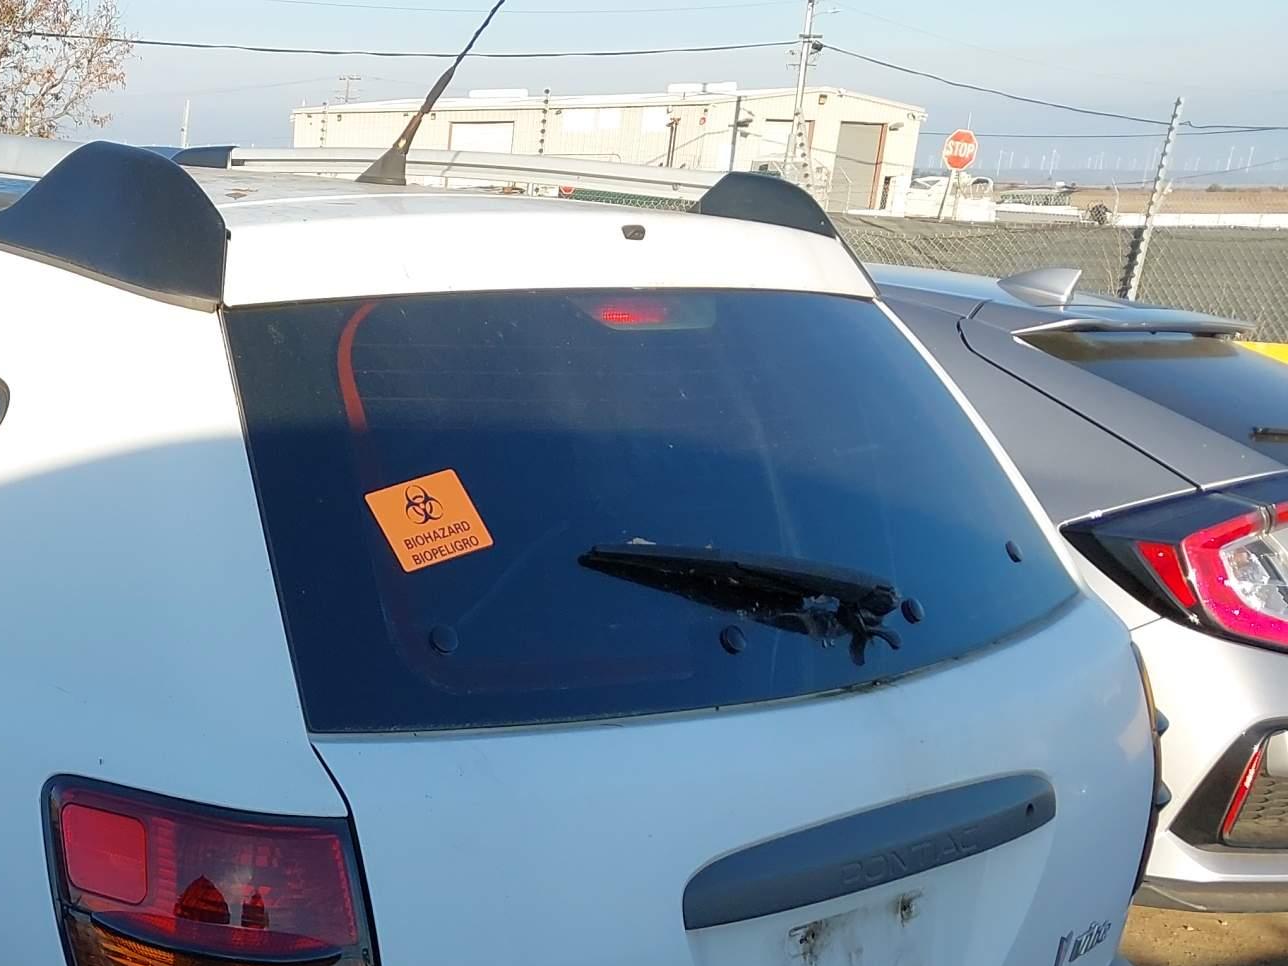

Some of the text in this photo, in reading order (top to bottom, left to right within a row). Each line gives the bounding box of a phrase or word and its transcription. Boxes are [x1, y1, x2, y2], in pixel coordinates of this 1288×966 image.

[946, 140, 975, 157] STOP
[404, 520, 471, 550] BIOHAZARD
[412, 535, 479, 565] BIOPELIGRO
[839, 824, 979, 887] PONTIAC
